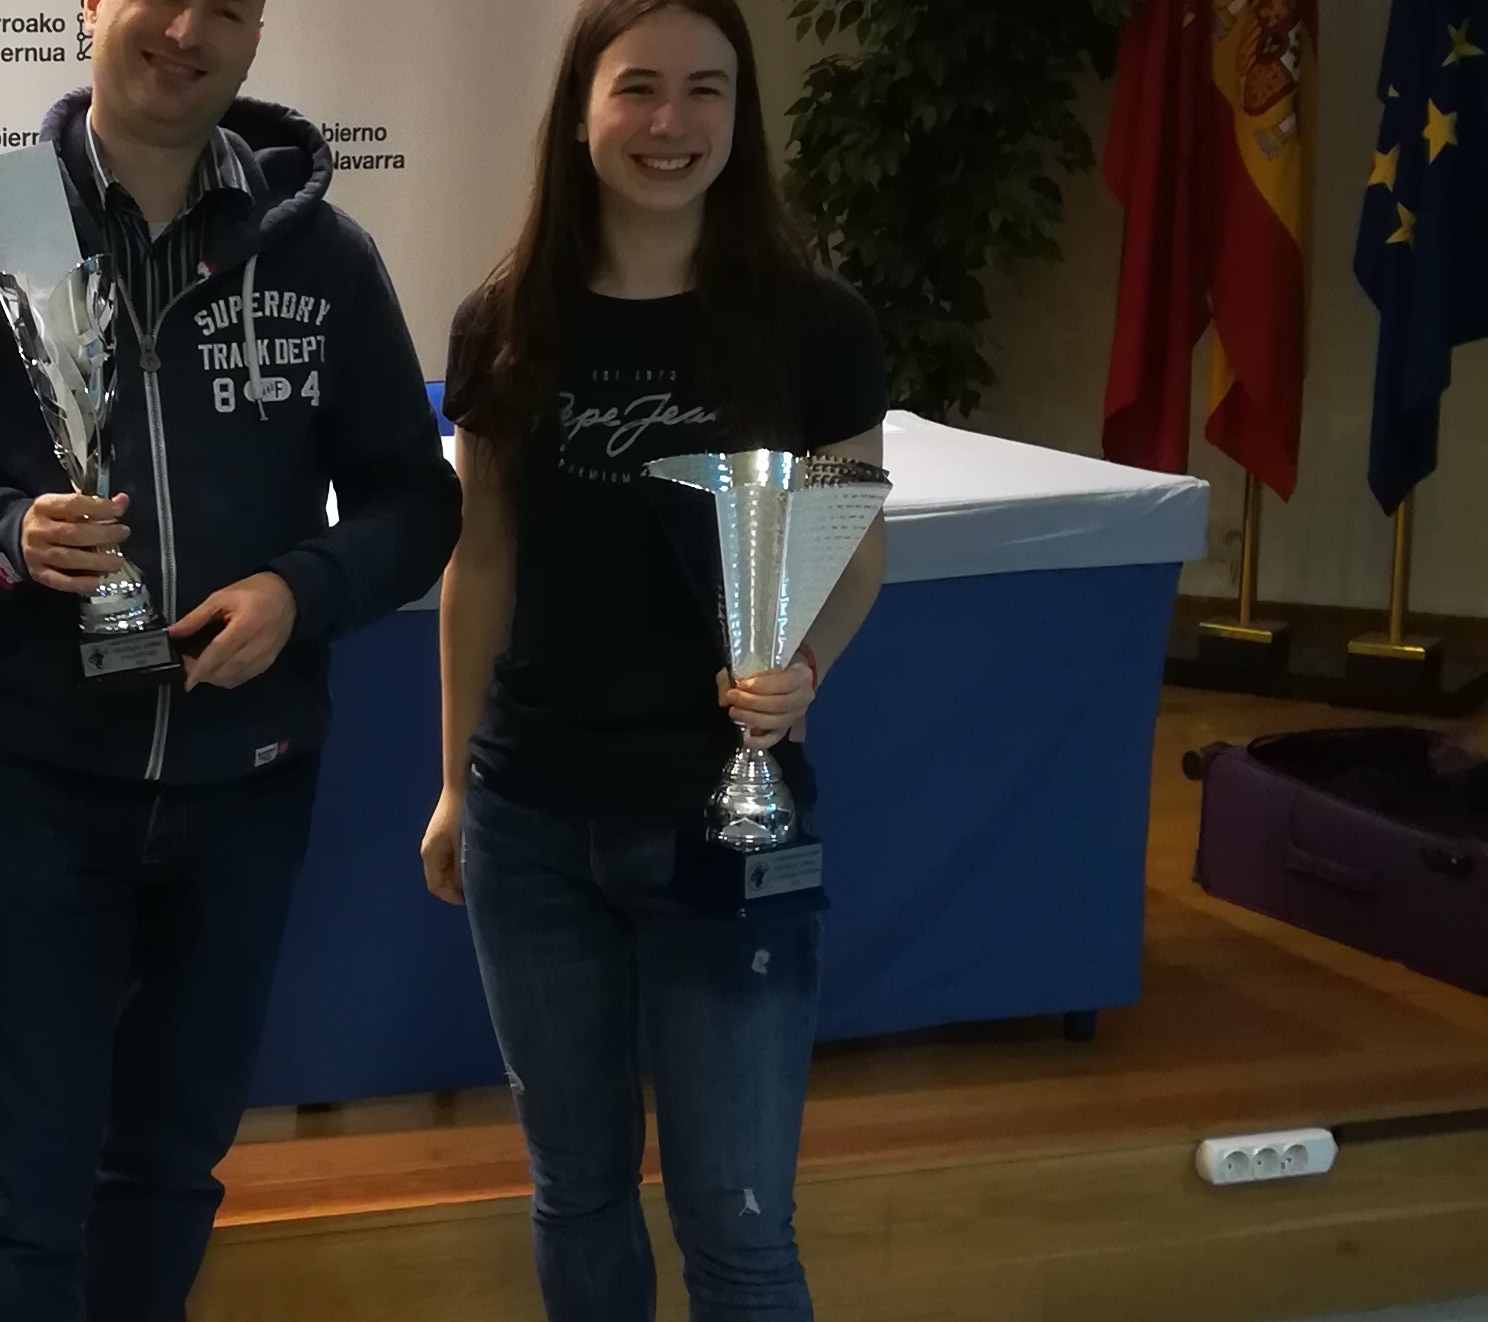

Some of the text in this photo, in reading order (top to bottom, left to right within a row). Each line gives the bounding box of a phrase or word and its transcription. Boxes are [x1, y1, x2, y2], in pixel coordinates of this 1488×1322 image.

[321, 122, 389, 143] bierno
[212, 377, 236, 413] 8
[300, 370, 320, 407] 4
